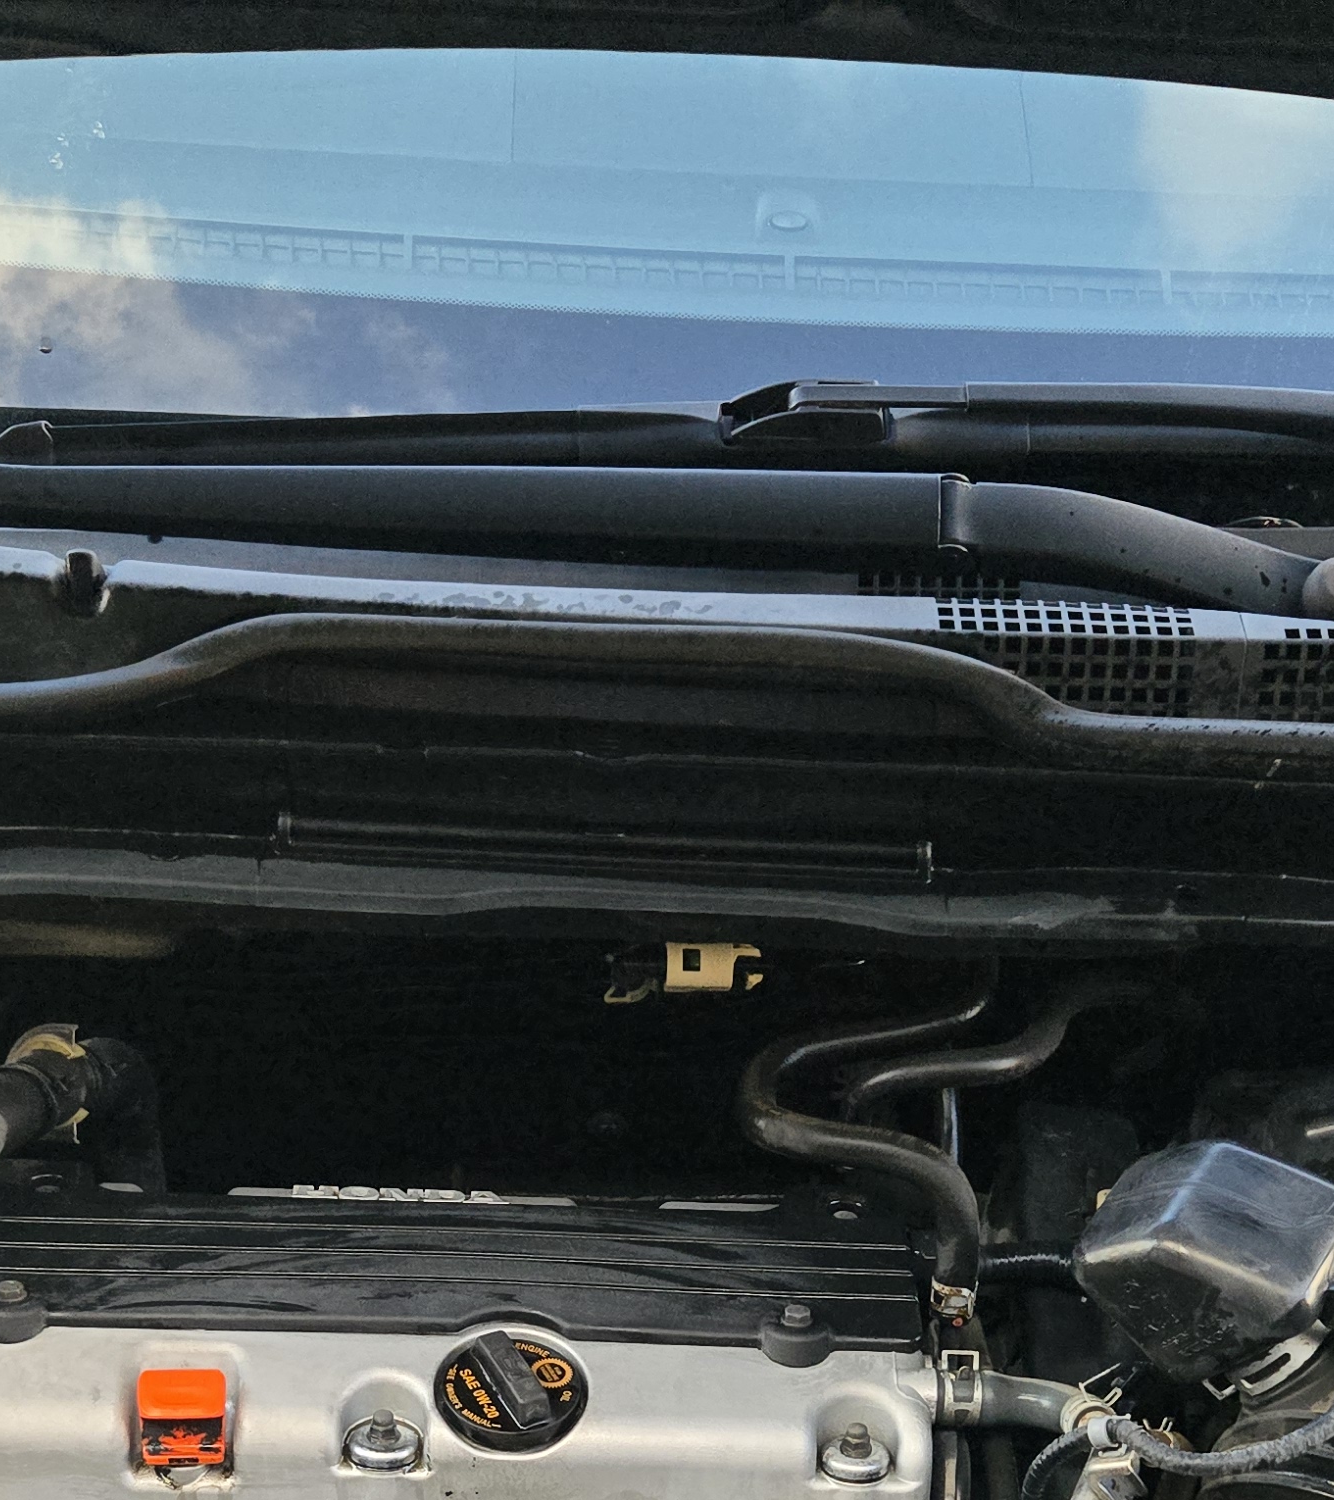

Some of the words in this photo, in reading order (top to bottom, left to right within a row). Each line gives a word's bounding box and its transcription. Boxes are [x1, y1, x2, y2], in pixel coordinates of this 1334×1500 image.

[292, 1184, 509, 1204] HONDA
[515, 1342, 550, 1358] ENGINE
[459, 1368, 481, 1390] SAE
[473, 1388, 500, 1419] 0W-20
[560, 1390, 572, 1402] OIL
[461, 1408, 492, 1428] MANUAL
